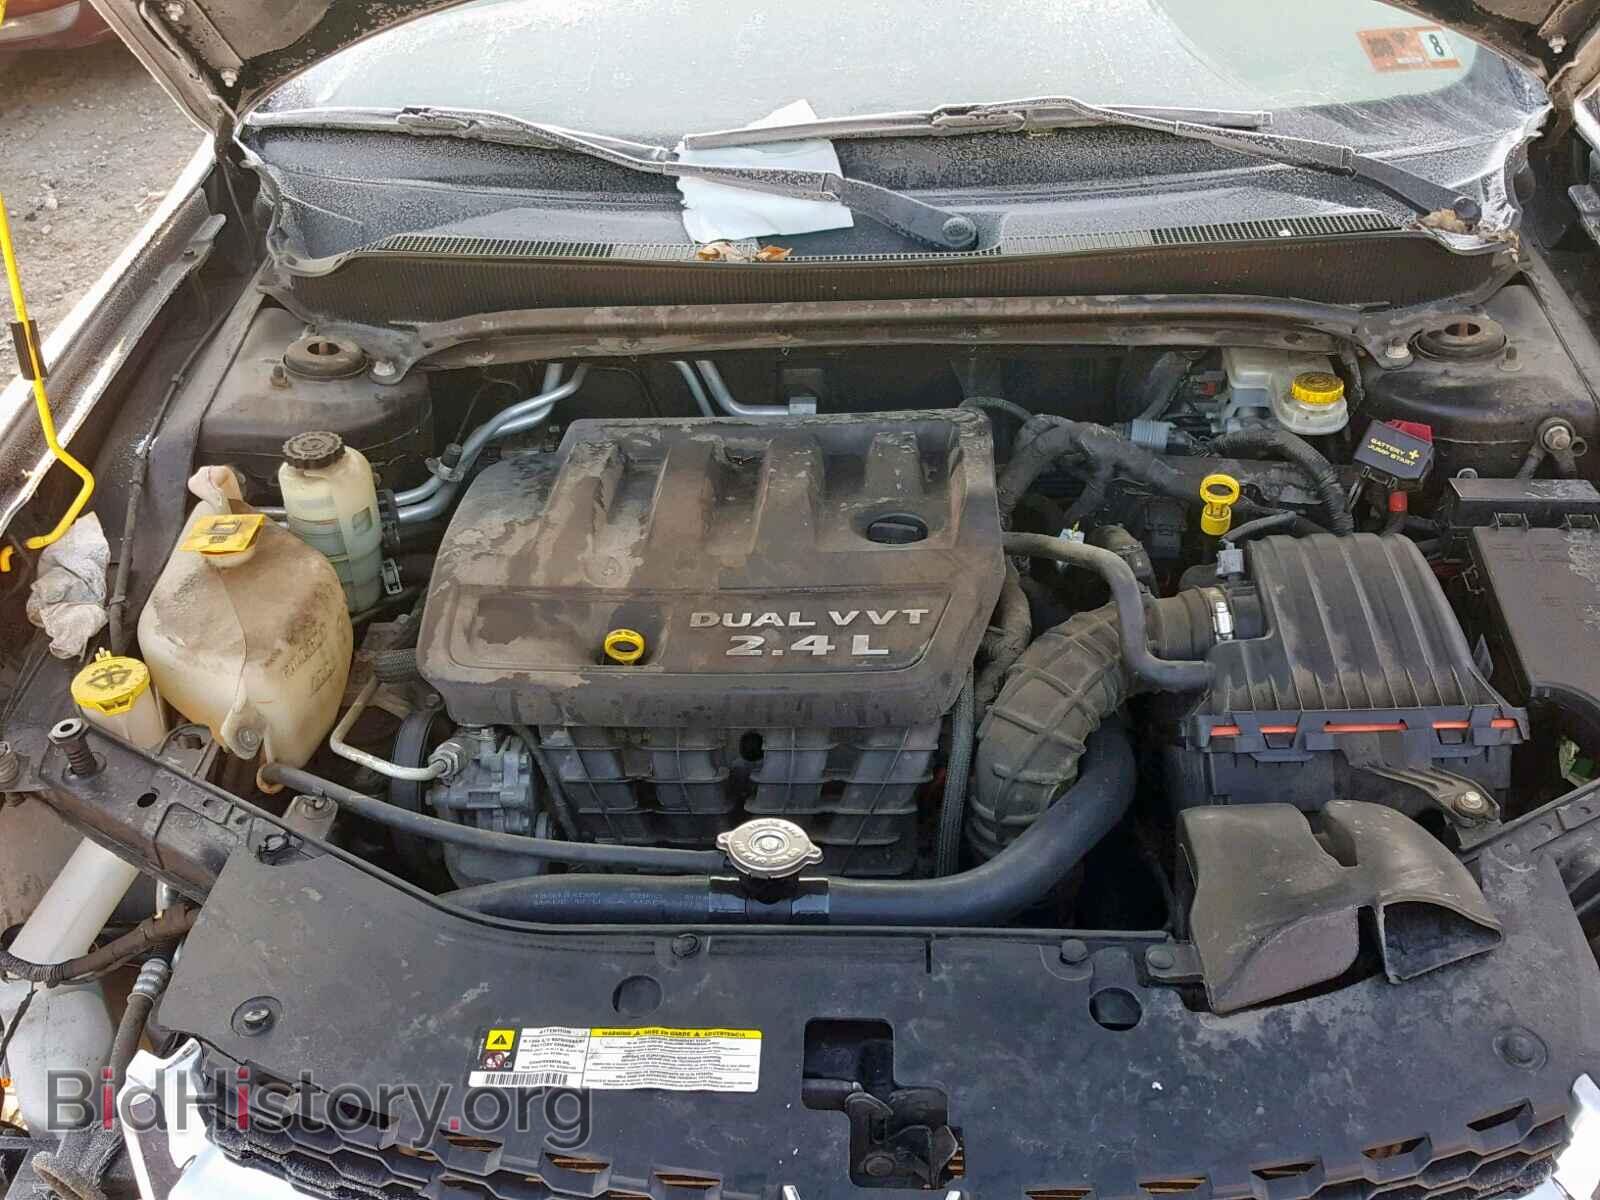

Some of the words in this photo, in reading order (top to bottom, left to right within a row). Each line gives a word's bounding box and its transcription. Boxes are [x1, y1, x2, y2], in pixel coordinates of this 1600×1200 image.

[1429, 34, 1445, 57] 8
[1370, 438, 1406, 455] BATTERY
[1390, 453, 1416, 465] START
[689, 611, 816, 628] DUAL
[828, 609, 929, 627] VVT
